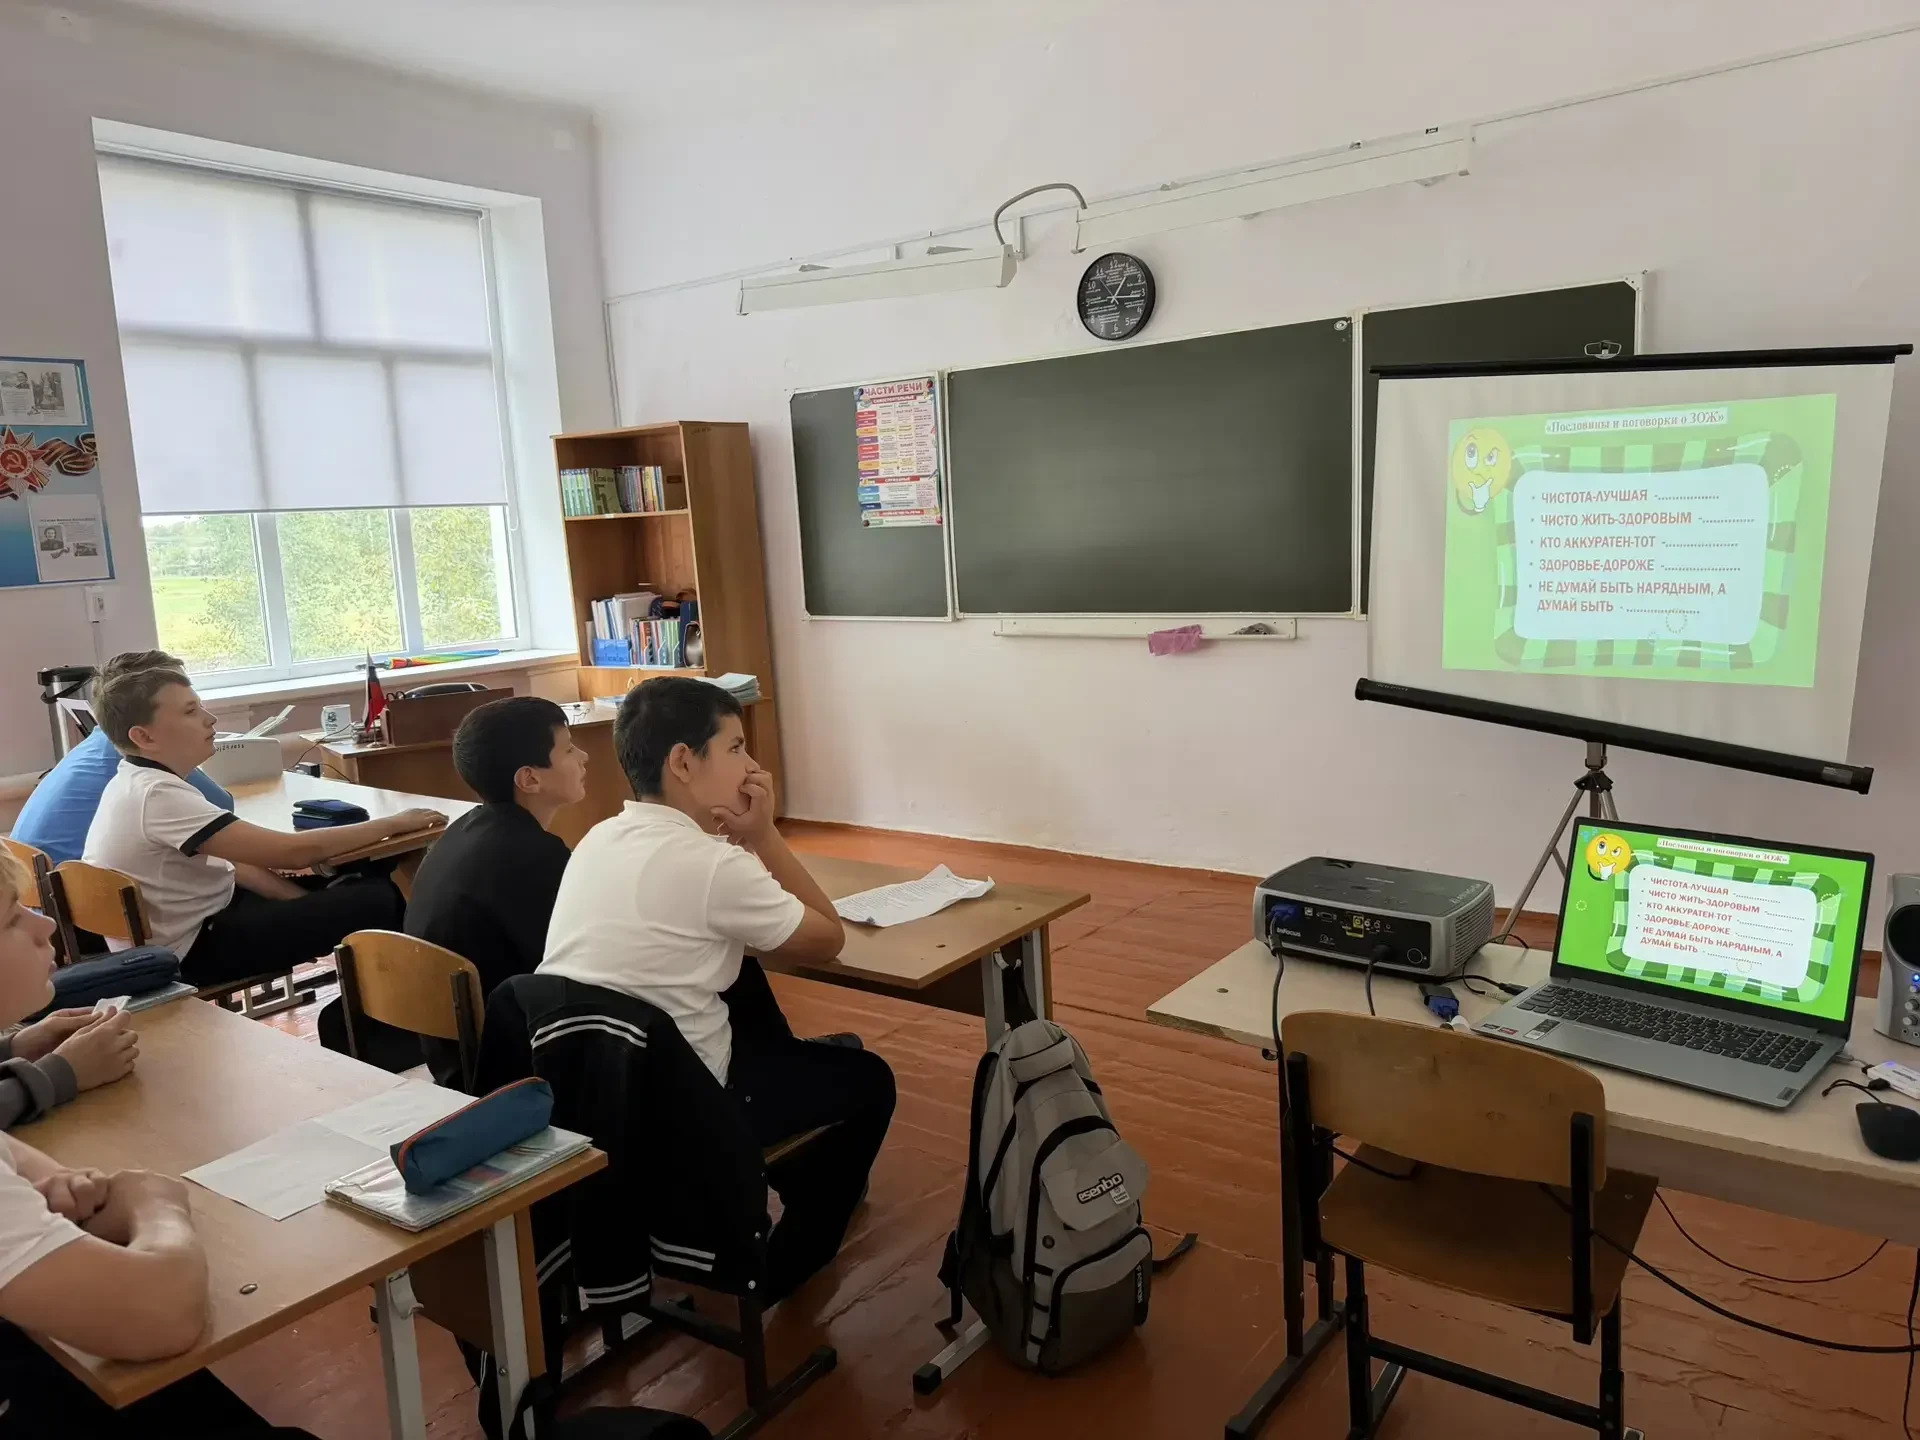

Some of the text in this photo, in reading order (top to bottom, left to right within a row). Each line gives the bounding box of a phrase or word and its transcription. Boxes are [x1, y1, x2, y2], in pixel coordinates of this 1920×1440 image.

[864, 382, 923, 396] ЧАСТИ РЕЧИ
[1546, 411, 1725, 433] «Пословицы и поговорки о ЗОЖ»
[1541, 489, 1648, 504] ЧИСТОТА-ЛУЧШАЯ
[1540, 511, 1692, 526] ЧИСТО ЖИТЬ-ЗДОРОВЫМ
[1540, 535, 1656, 549] КТО АККУРАТЕН-ТОТ
[1539, 558, 1655, 572] ЗДОРОВЬЕ-ДОРОЖЕ
[1538, 578, 1727, 596] НЕ ДУМАЙ БЫТЬ НАРЯДНЫМ, А
[1537, 597, 1614, 612] ДУМАЙ БЫТЬ
[1650, 877, 1729, 896] ЧИСТОТА-ЛУЧШАЯ
[1648, 889, 1760, 914] ЧИСТО ЖИТЬ-ЗДОРОВЫМ
[1646, 902, 1733, 922] КТО АККУРАТЕН-ТОТ
[1644, 913, 1731, 936] ЗДОРОВЬЕ-ДОРОЖЕ
[1640, 936, 1698, 953] ДУМАЙ БЫТЬ
[1642, 926, 1783, 958] НЕ ДУМАЙ БЫТЬ НАРЯДНЫМ, А
[1078, 1174, 1123, 1202] esenbo
